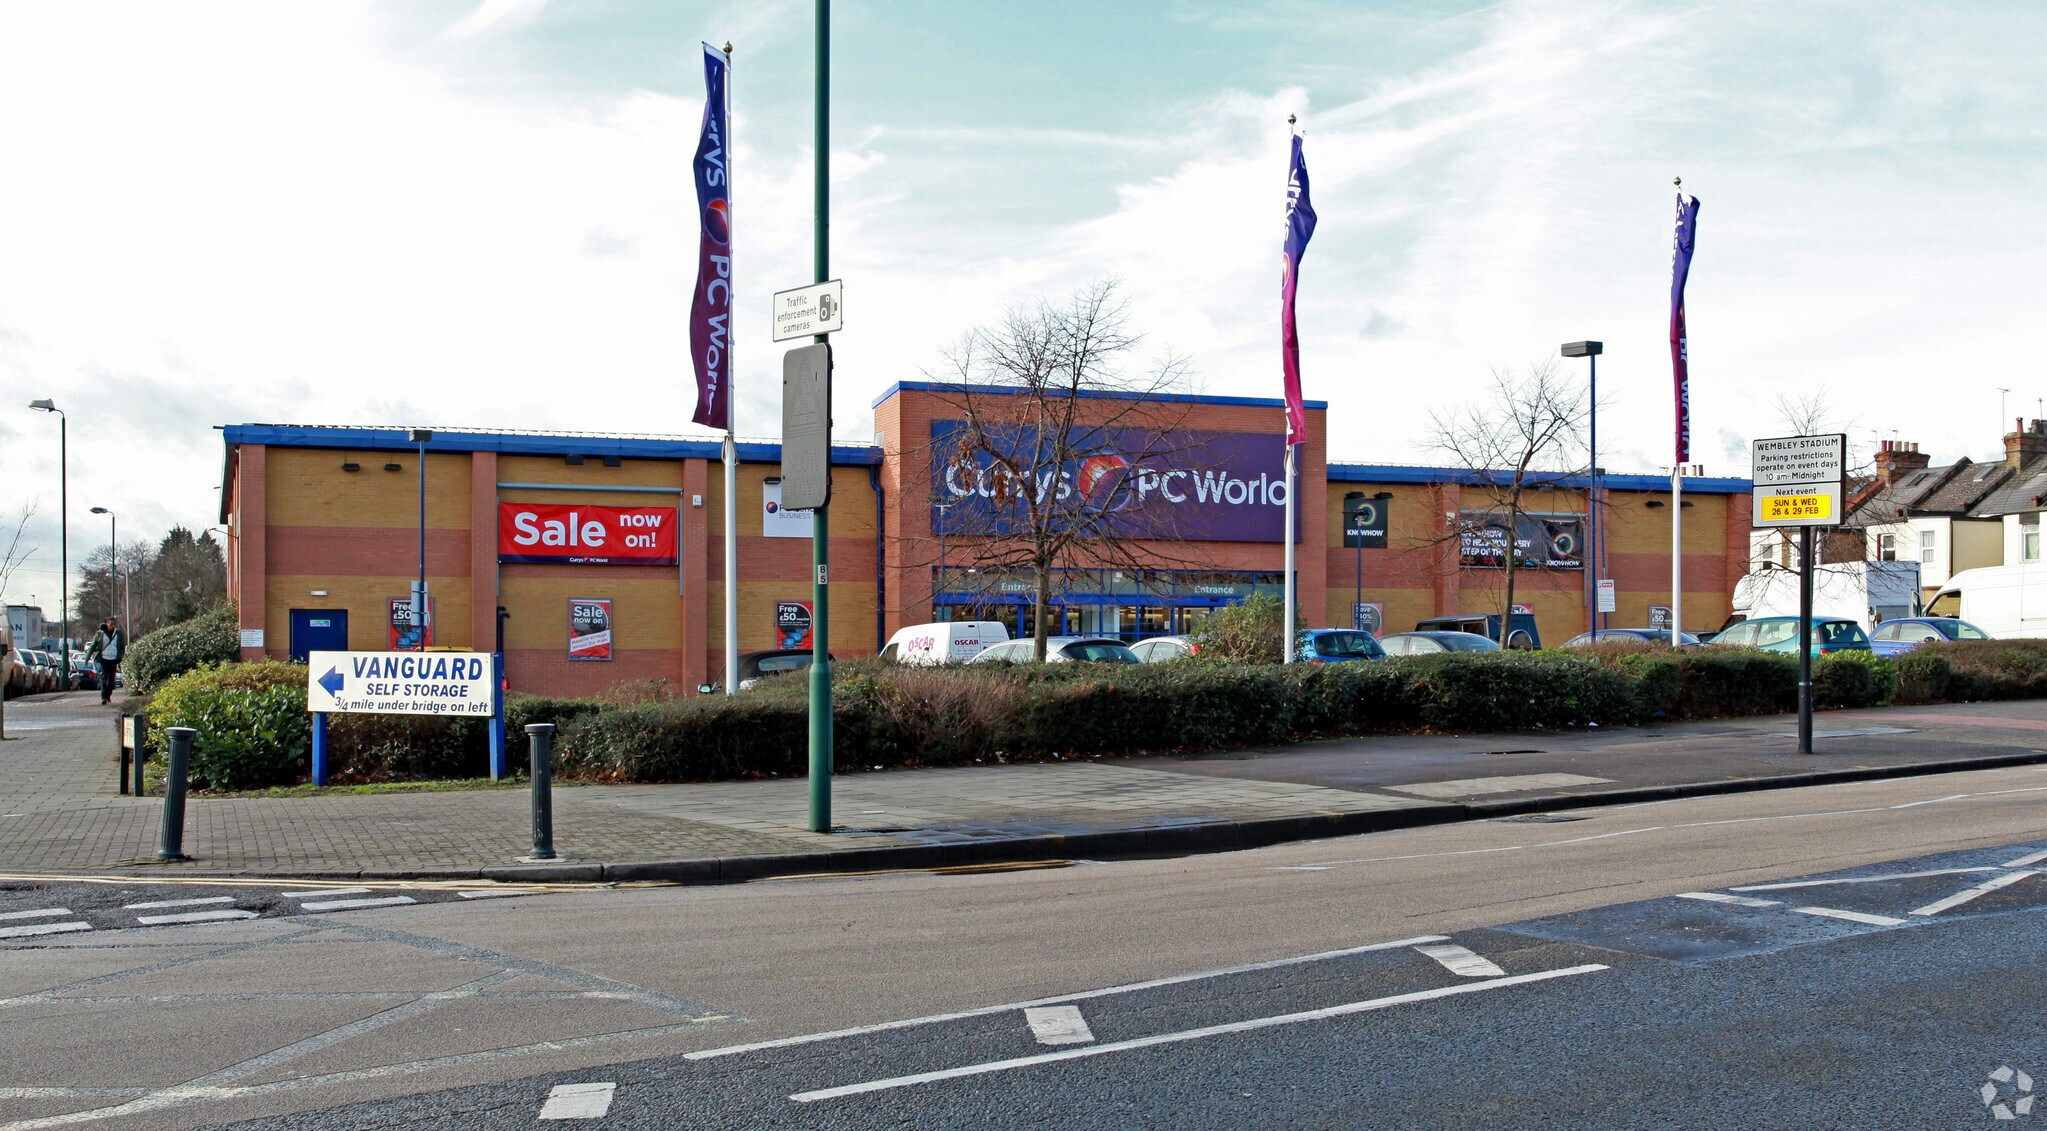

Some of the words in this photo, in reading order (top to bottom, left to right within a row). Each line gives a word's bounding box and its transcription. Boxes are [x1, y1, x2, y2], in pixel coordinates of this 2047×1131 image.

[707, 254, 730, 306] PC
[786, 295, 807, 308] Traffic
[777, 305, 817, 322] enforcement
[783, 321, 811, 333] cameras
[1757, 441, 1798, 451] WEMBLEY
[1800, 438, 1838, 448] STADIUM
[1761, 454, 1788, 462] Parking
[1790, 452, 1833, 460] restrictions
[1756, 464, 1784, 472] operate
[1820, 460, 1838, 469] days
[1765, 473, 1774, 481] 10
[1791, 471, 1825, 480] Midnight
[1138, 468, 1188, 502] PC
[1795, 487, 1817, 495] event
[1773, 499, 1790, 507] SUN
[779, 512, 811, 520] BUSINESS
[1771, 508, 1782, 516] 26
[1792, 507, 1803, 515] 29
[1804, 506, 1819, 514] FEB
[513, 511, 607, 547] Sale
[619, 514, 662, 528] now
[624, 532, 657, 548] on!
[1194, 585, 1234, 594] Entrance
[574, 605, 604, 617] Sale
[779, 605, 798, 613] Free
[1651, 608, 1666, 616] Free
[780, 612, 796, 621] £50
[908, 636, 935, 653] OSCAR
[353, 656, 483, 681] VANGUARD
[366, 683, 400, 696] SELF
[404, 684, 469, 698] STORAGE
[351, 699, 374, 710] mile
[378, 700, 409, 711] under
[412, 701, 447, 714] bridge
[451, 704, 464, 712] on
[468, 701, 488, 713] left
